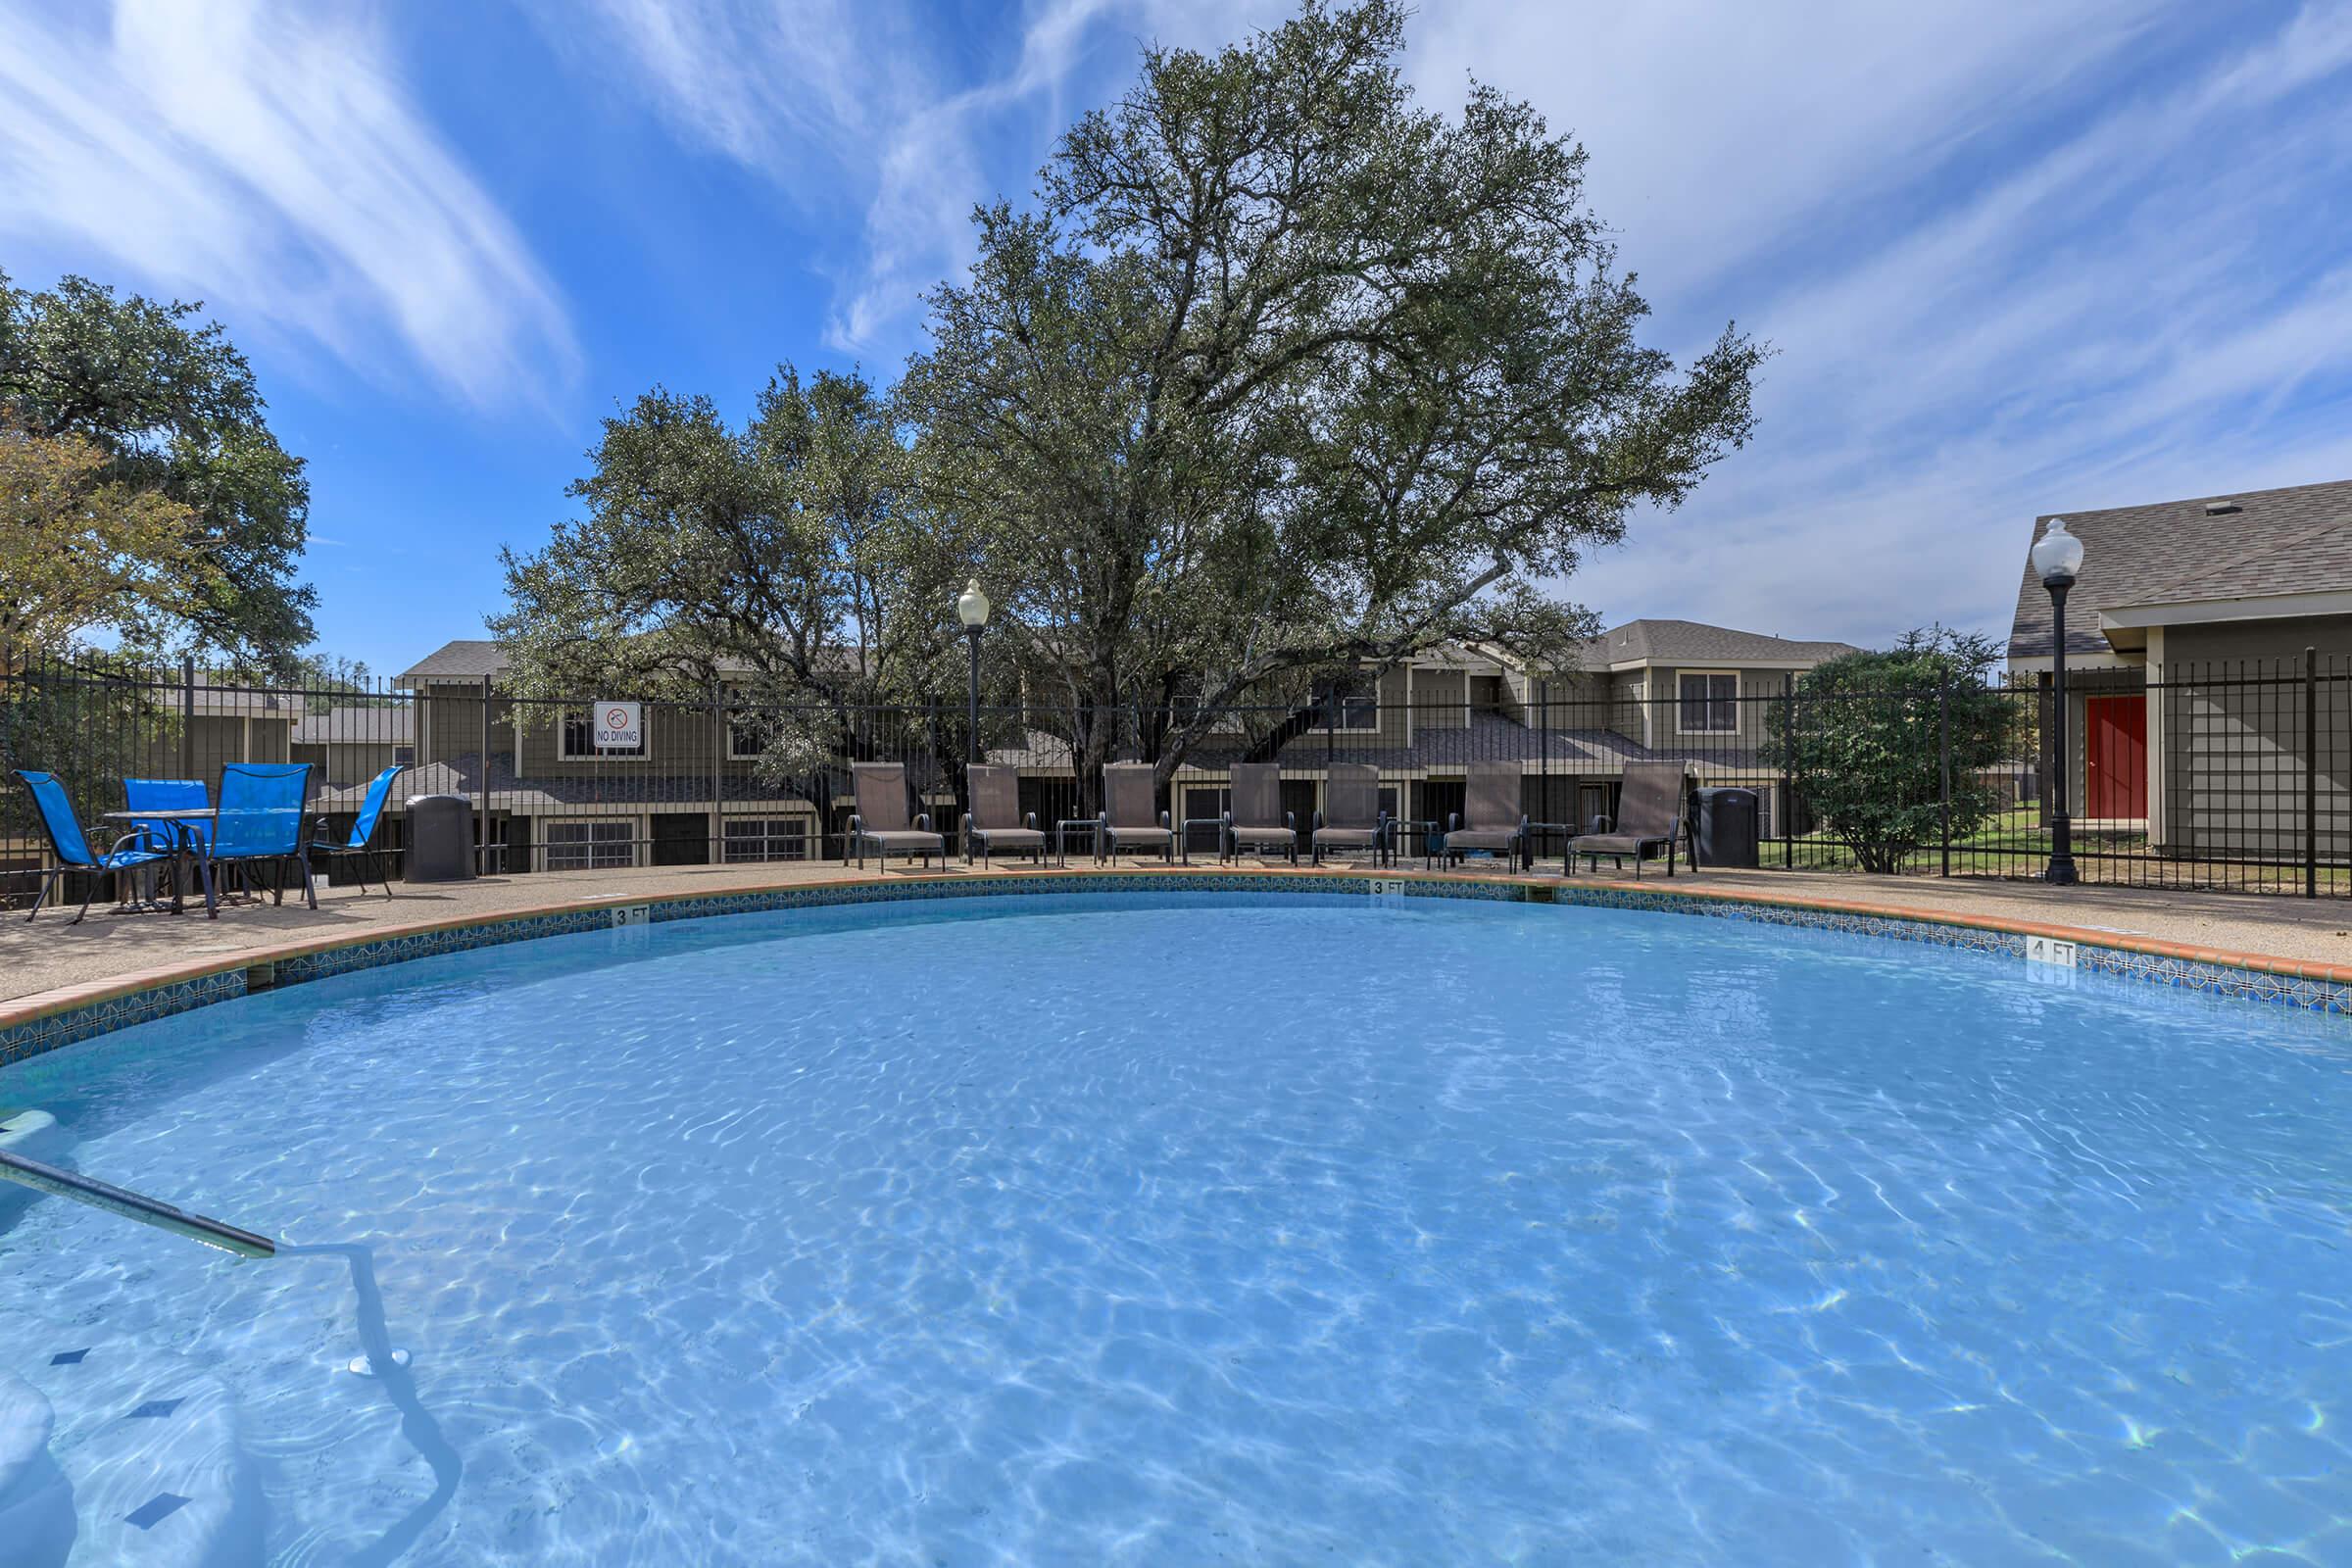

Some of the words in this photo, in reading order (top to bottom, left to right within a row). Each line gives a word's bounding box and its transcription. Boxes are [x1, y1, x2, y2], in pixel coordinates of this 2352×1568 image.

[597, 730, 609, 742] NO
[612, 730, 637, 742] DIVING
[1374, 881, 1383, 894] 3
[1389, 881, 1402, 894] FT
[617, 909, 627, 925] 3
[632, 907, 648, 922] FT
[2033, 940, 2045, 960] 4
[2054, 942, 2074, 965] FT
